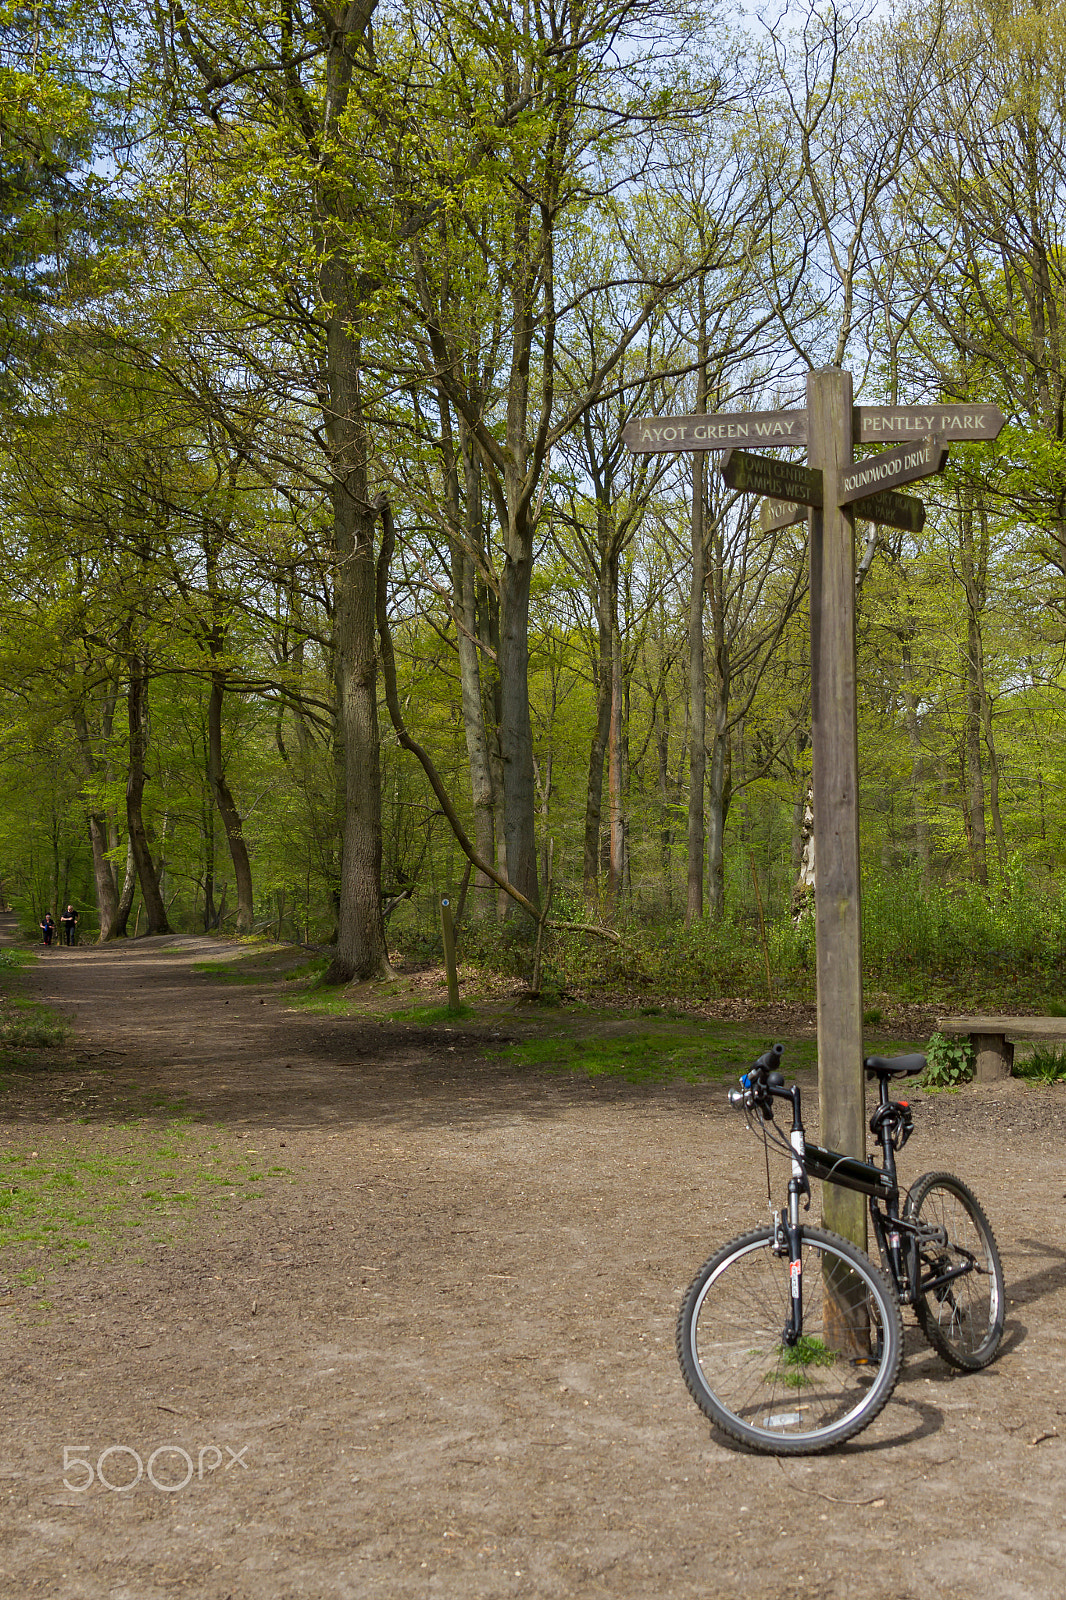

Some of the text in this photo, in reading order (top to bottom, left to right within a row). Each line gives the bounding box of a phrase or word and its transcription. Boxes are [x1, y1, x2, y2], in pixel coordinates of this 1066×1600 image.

[642, 422, 794, 442] AYOT GREEN WAY
[863, 415, 985, 431] PENTLEY PARK
[739, 457, 771, 475] TOWN
[844, 448, 930, 492] ROUNDWOOD DRIVE
[736, 473, 811, 500] CAMPUS WEST
[875, 505, 896, 522] PARK
